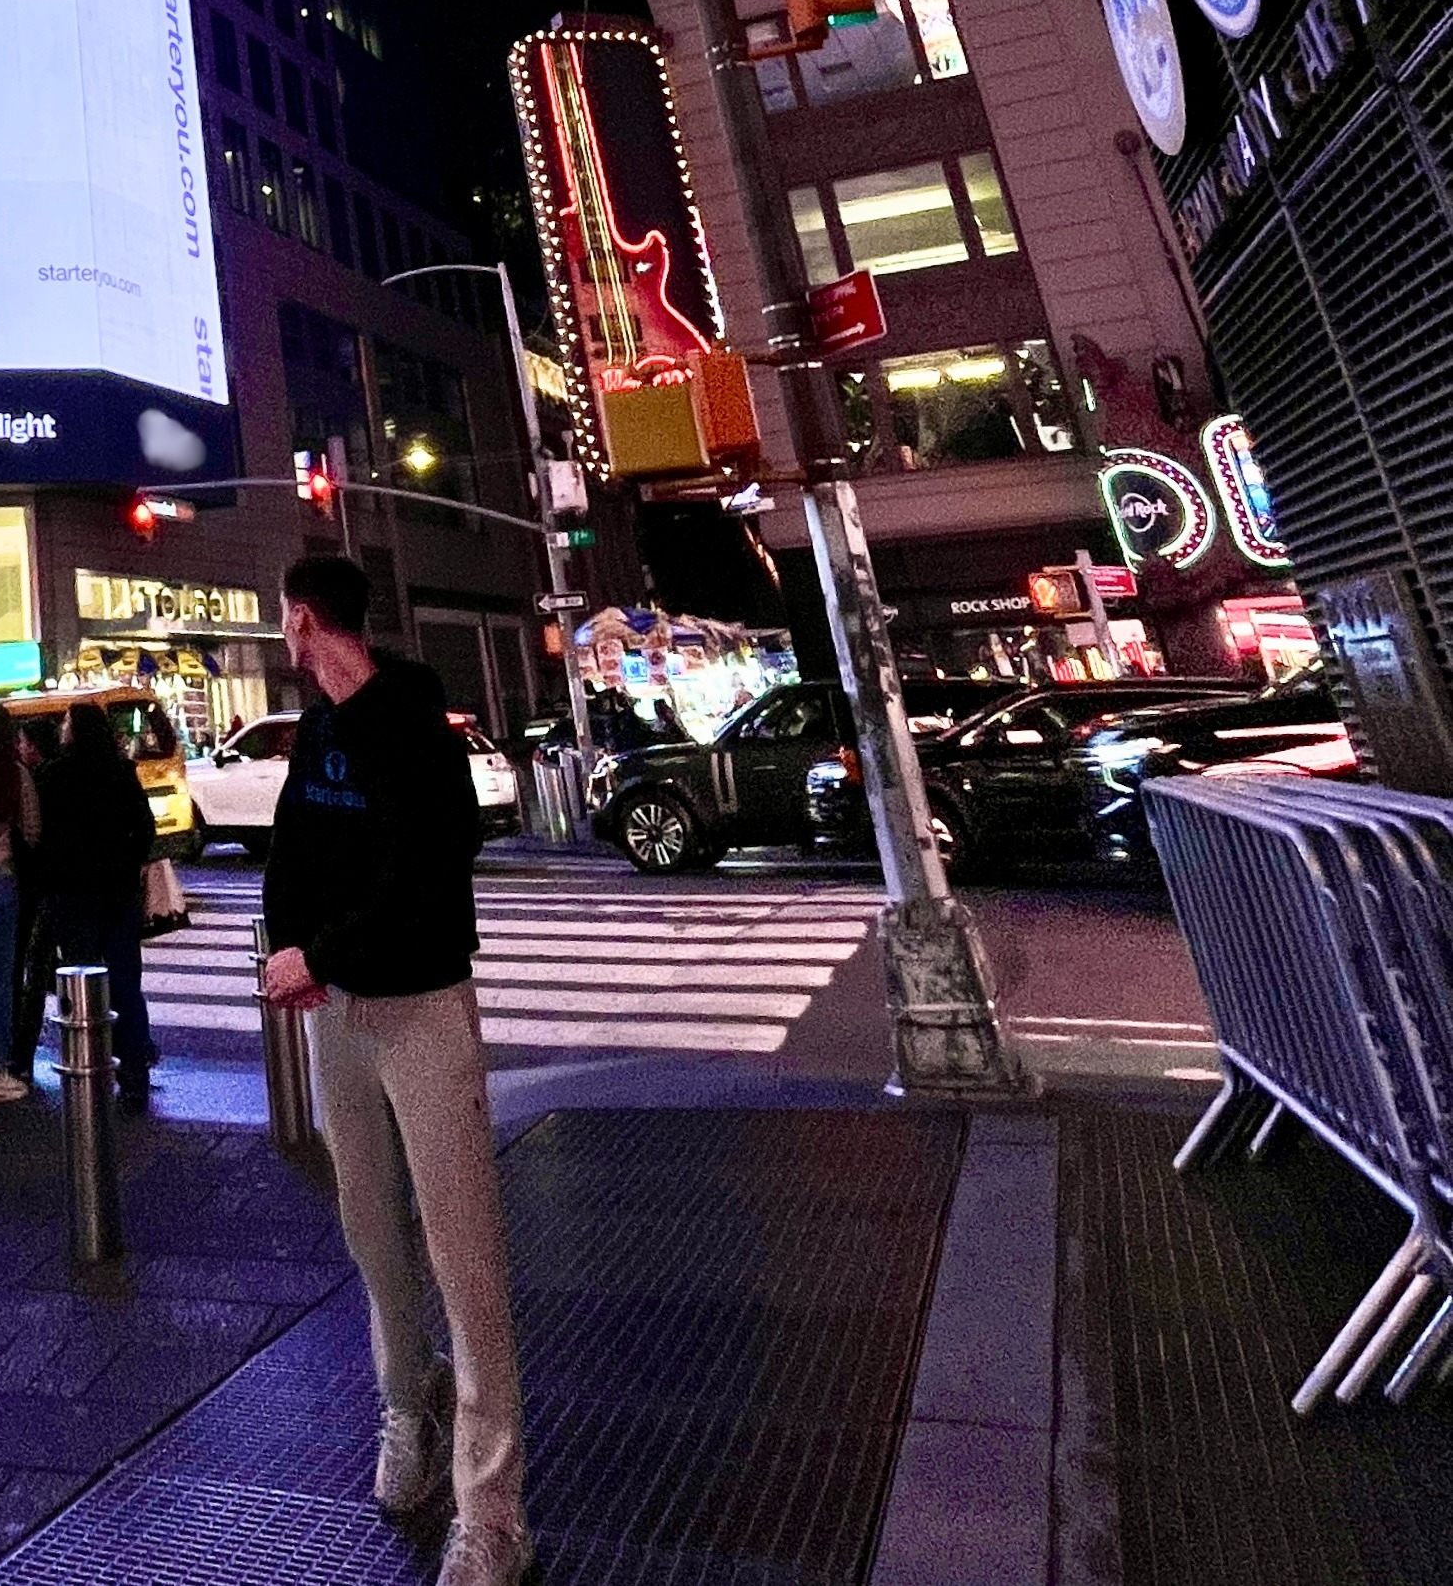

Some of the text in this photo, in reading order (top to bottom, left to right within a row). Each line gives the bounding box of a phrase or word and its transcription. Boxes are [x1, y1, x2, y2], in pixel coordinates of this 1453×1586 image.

[37, 262, 143, 298] starteryou.com
[1134, 498, 1169, 518] Rock
[143, 584, 225, 622] TOURO
[951, 596, 1030, 615] ROCK SHOP
